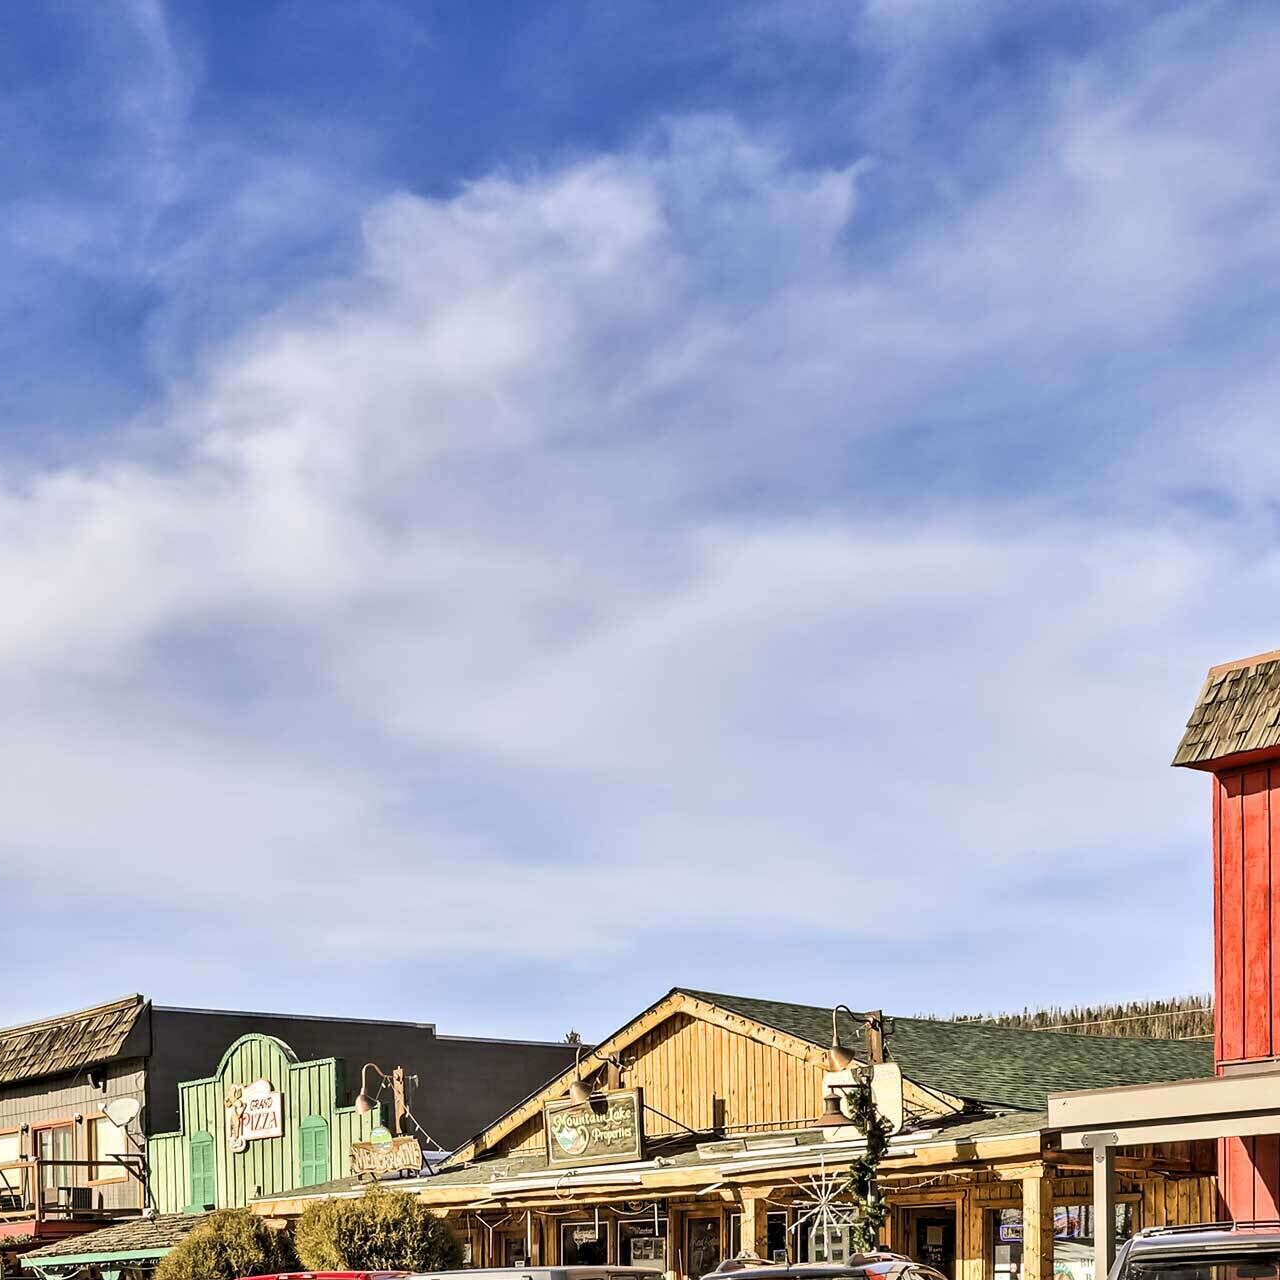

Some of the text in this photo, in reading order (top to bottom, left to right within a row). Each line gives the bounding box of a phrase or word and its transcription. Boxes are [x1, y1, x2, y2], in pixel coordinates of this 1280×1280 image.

[250, 1096, 273, 1111] GRAND
[240, 1111, 278, 1136] PIZZA
[552, 1104, 632, 1127] Mountain Lake
[591, 1126, 632, 1146] Properties
